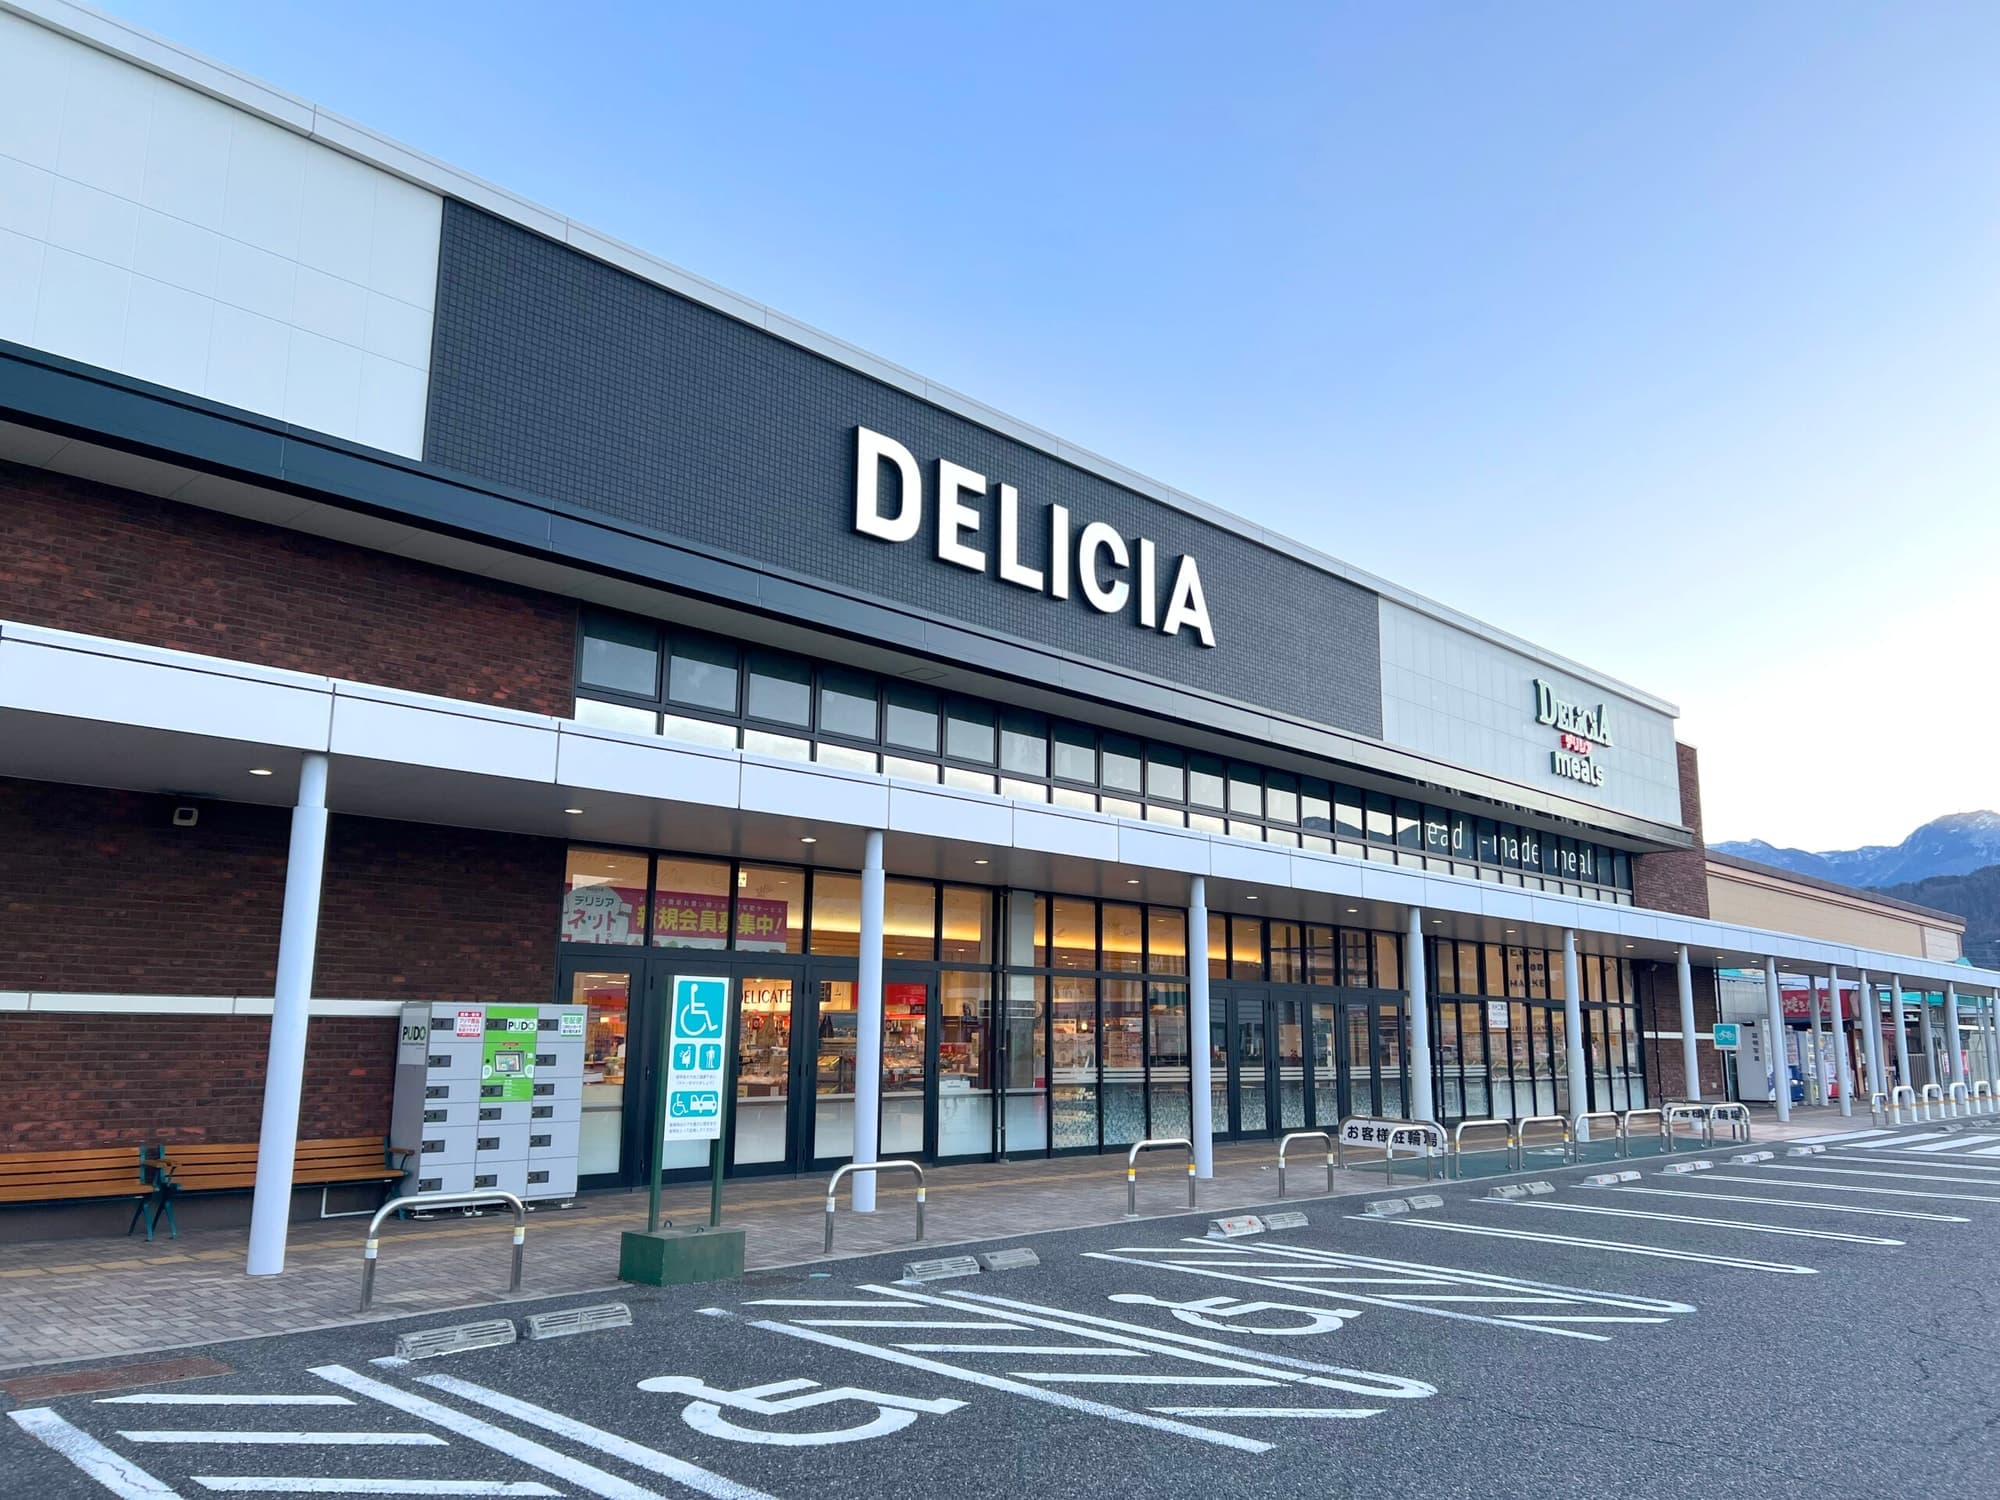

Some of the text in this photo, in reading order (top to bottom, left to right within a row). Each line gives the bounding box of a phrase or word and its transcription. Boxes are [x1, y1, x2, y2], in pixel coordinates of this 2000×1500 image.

[855, 425, 1216, 648] DELICIA
[1552, 751, 1604, 786] meals
[568, 908, 616, 931] ネット
[402, 1026, 426, 1040] PUDO
[508, 1021, 536, 1030] PUDO
